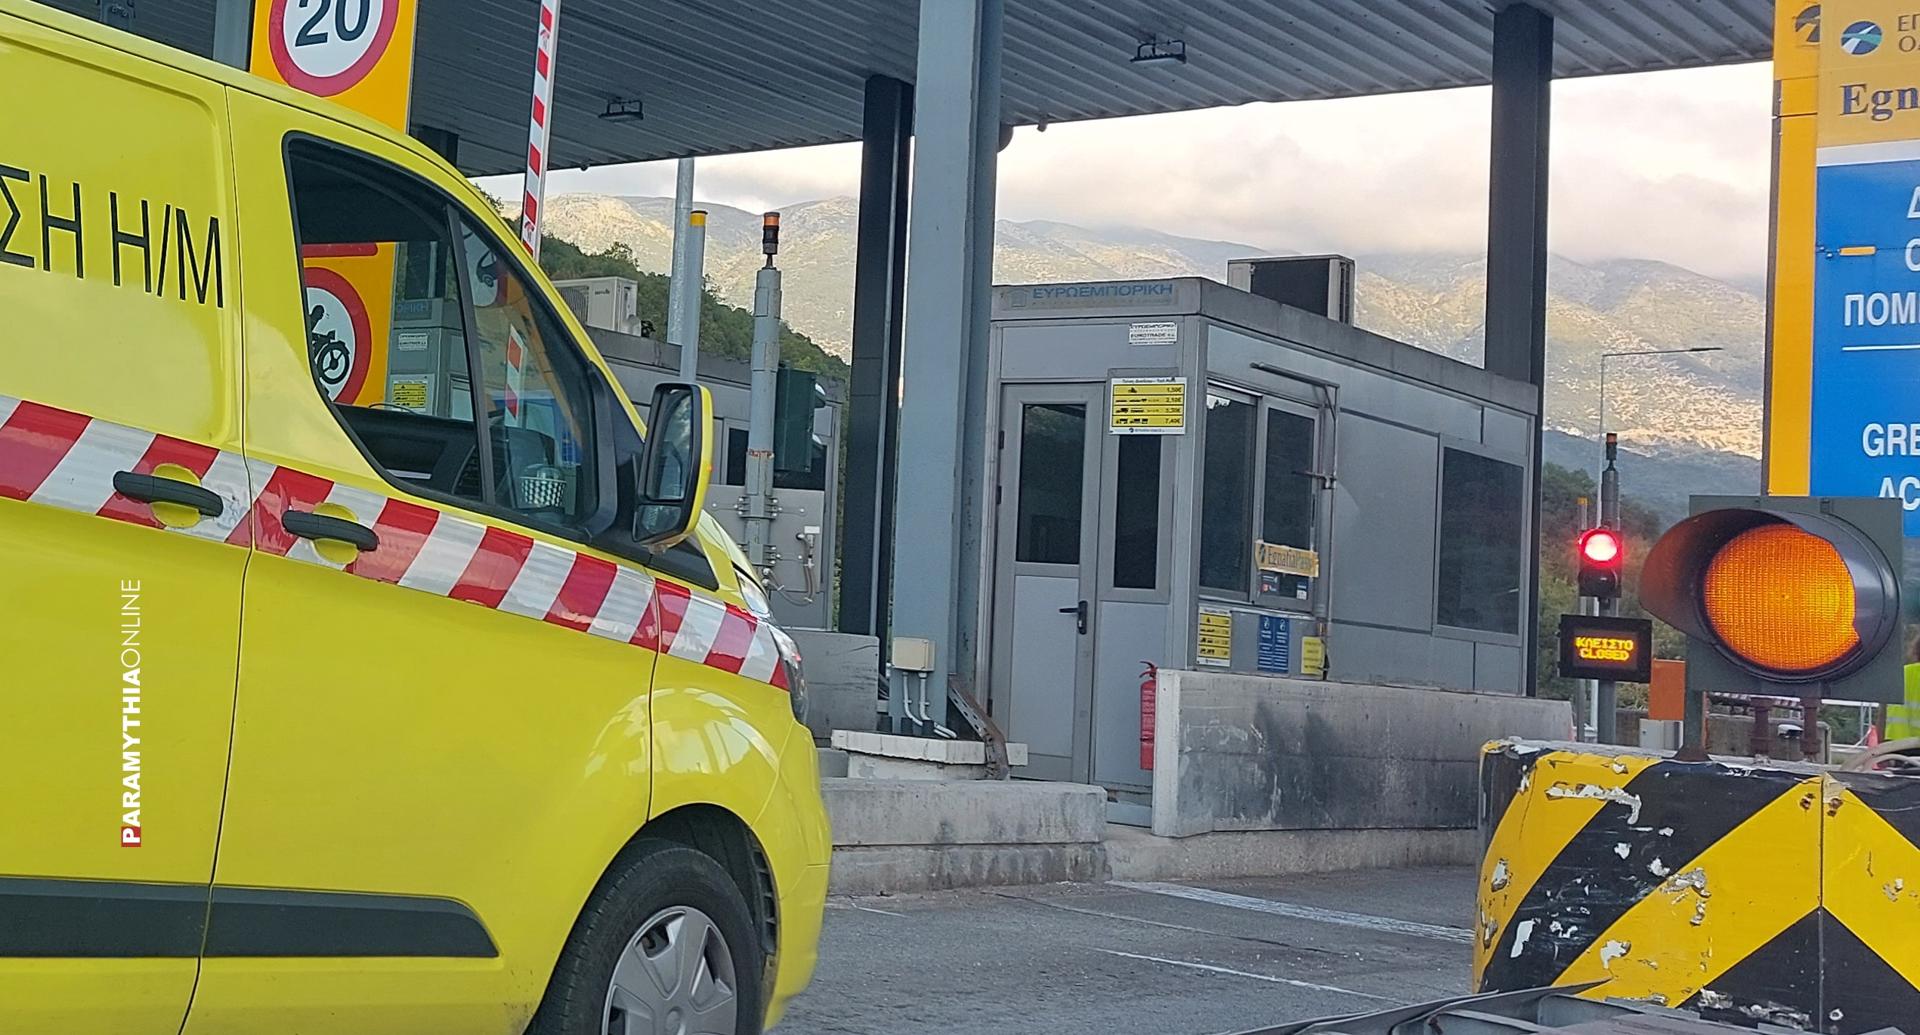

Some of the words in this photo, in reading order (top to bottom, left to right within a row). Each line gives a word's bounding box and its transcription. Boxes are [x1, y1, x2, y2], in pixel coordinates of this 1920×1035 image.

[295, 0, 370, 47] 20
[109, 191, 223, 308] Η/Μ
[1032, 283, 1173, 299] ΕΥΡΩΕΜΠΟΡΙΚΗ
[1844, 292, 1920, 326] ΠΟΜ
[1575, 636, 1634, 651] ΚΛΕΙΣΤΟ
[1580, 647, 1630, 661] CLOSED
